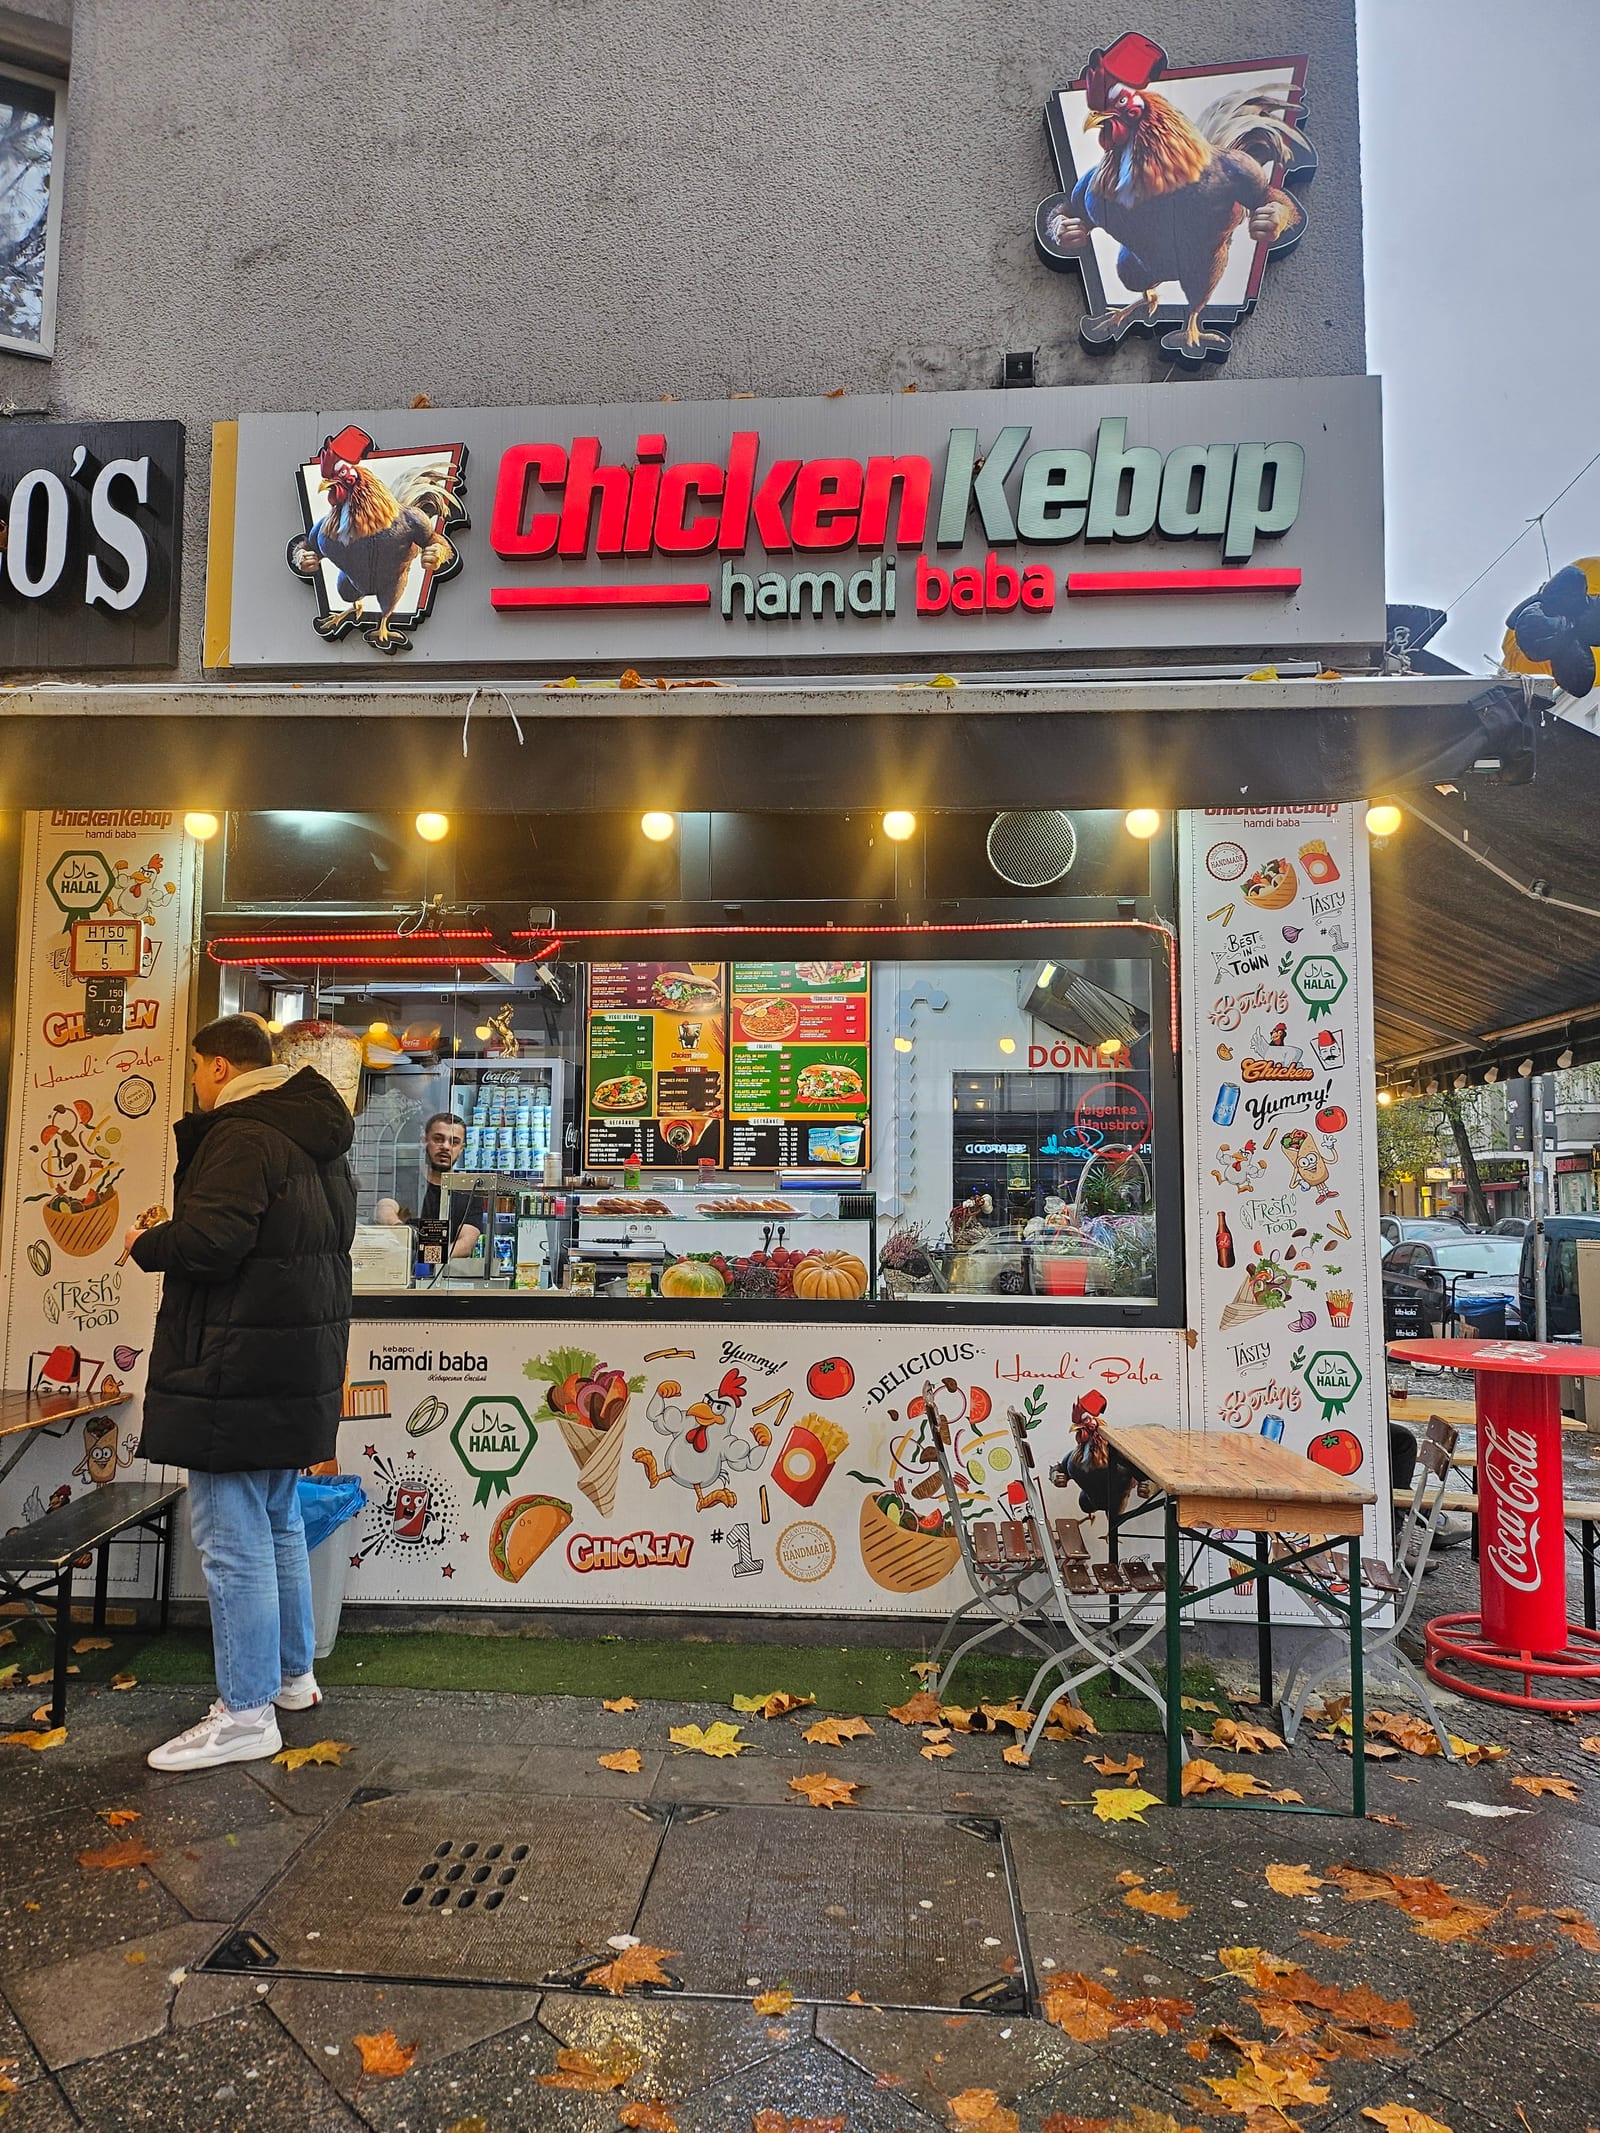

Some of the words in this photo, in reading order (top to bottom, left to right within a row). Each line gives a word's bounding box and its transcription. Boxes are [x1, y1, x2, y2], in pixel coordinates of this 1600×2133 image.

[0, 444, 150, 612] O'S
[720, 554, 897, 621] hamdi
[915, 551, 1056, 617] baba
[1243, 818, 1274, 828] hamdi
[1276, 817, 1300, 827] baba
[85, 829, 113, 839] hamdi
[115, 829, 137, 839] baba
[1210, 854, 1244, 868] HANDMADE
[60, 880, 101, 894] HALAL
[1302, 891, 1346, 917] TASTY
[1227, 931, 1260, 953] BEST
[1242, 947, 1253, 958] IN
[1228, 954, 1270, 976] TOWN
[88, 985, 98, 998] S
[109, 989, 123, 998] 150
[1304, 978, 1337, 990] HALAL
[43, 998, 160, 1047] CHEN
[1028, 1040, 1133, 1069] DÖNER
[34, 1055, 103, 1088] Hamdi
[106, 1046, 165, 1070] Baba
[1240, 1057, 1315, 1083] Chicken
[1083, 1105, 1138, 1118] eigenes
[1245, 1079, 1333, 1130] Yummy!
[1082, 1118, 1146, 1131] Hausbrot
[1264, 1219, 1298, 1235] FOOD
[72, 1309, 120, 1331] FOOD
[369, 1350, 433, 1371] hamdi
[439, 1350, 488, 1371] baba
[720, 1340, 789, 1375] Yummy!
[1227, 1342, 1271, 1367] TASTY
[869, 1342, 976, 1404] DELICIOUS
[995, 1352, 1085, 1382] Hamdi
[1089, 1356, 1164, 1384] Baba
[1316, 1376, 1351, 1387] HALAL
[469, 1435, 521, 1453] HALAL
[1485, 1415, 1541, 1592] Coca-Cola
[566, 1531, 695, 1574] CHICKEN
[782, 1542, 830, 1561] HANDMADE
